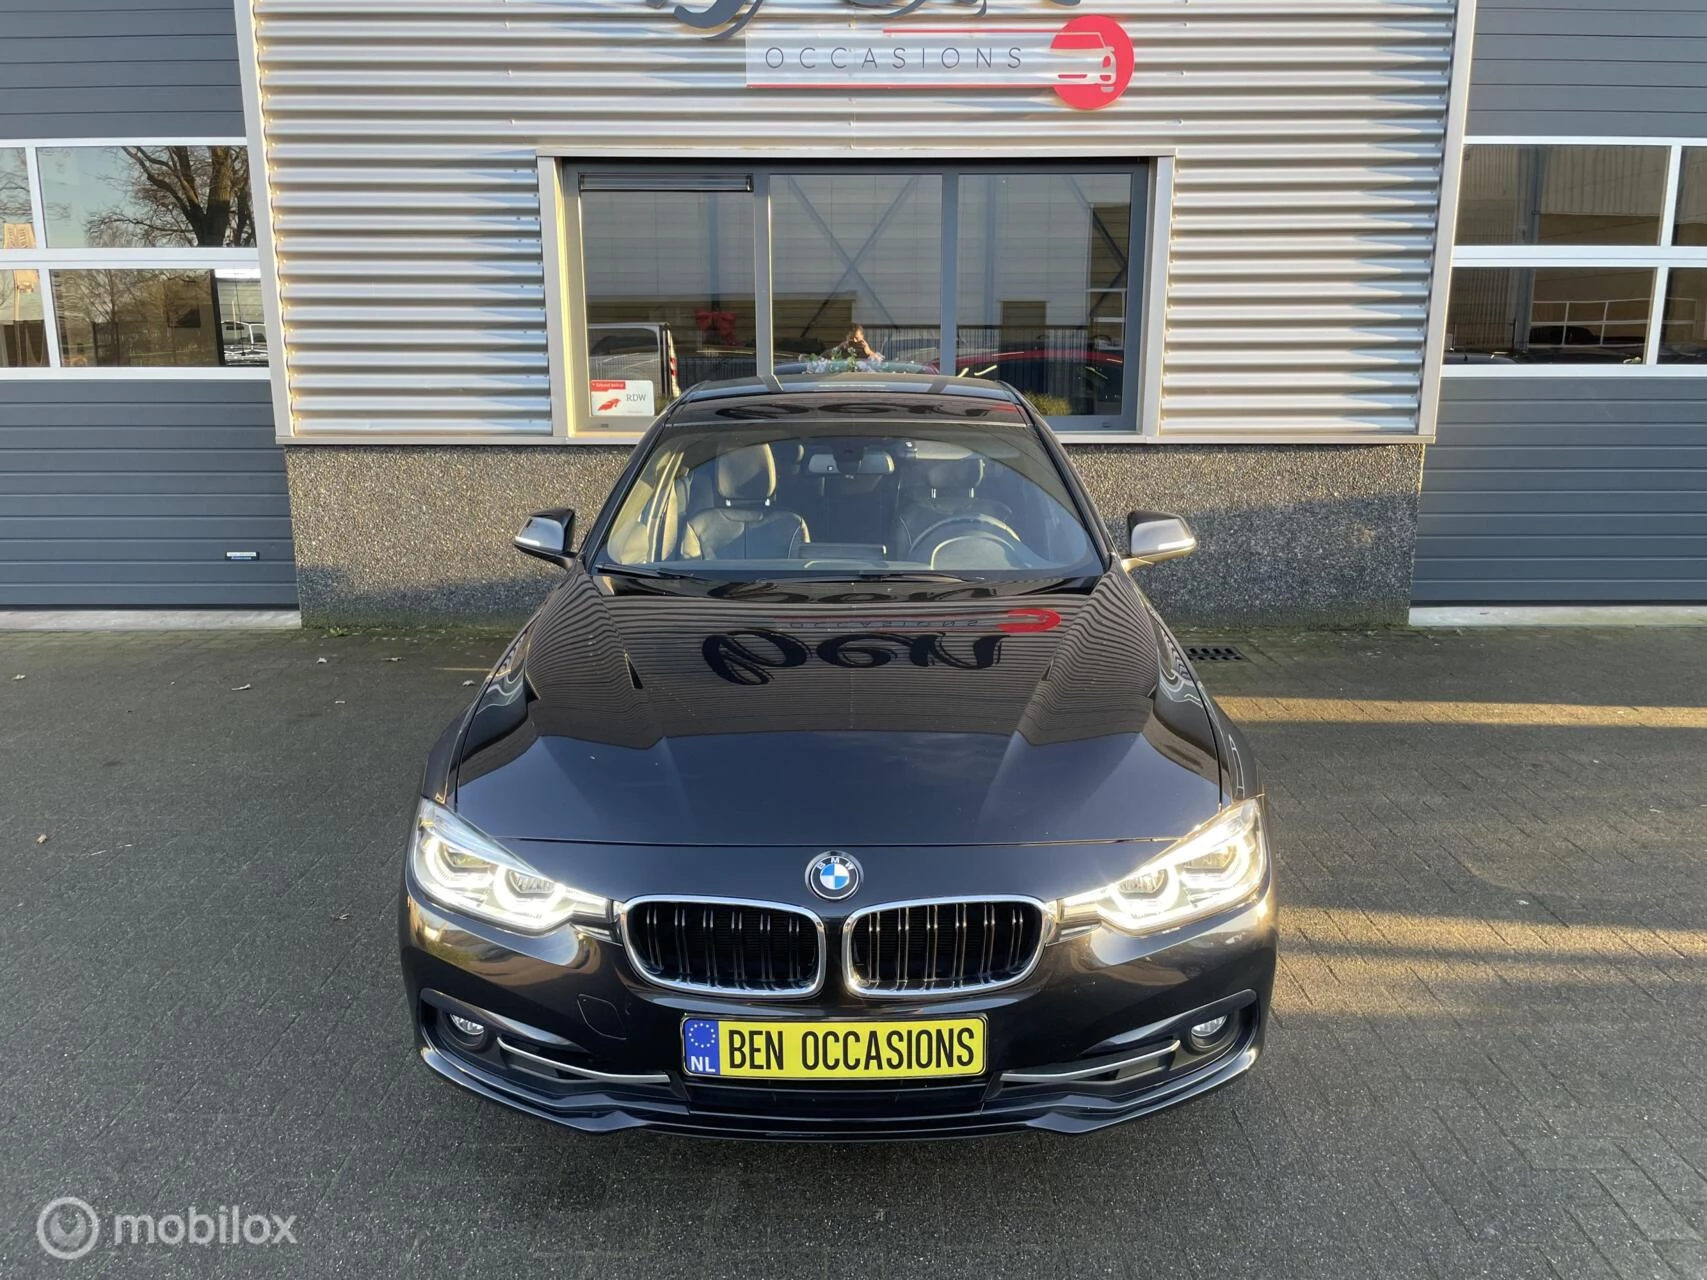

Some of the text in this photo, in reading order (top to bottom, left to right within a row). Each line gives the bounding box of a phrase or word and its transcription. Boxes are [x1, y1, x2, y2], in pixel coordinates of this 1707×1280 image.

[766, 48, 1022, 69] OCCASIONS
[817, 857, 855, 870] BMW
[728, 1027, 974, 1070] BEN OCCASIONS
[691, 1055, 716, 1072] NL
